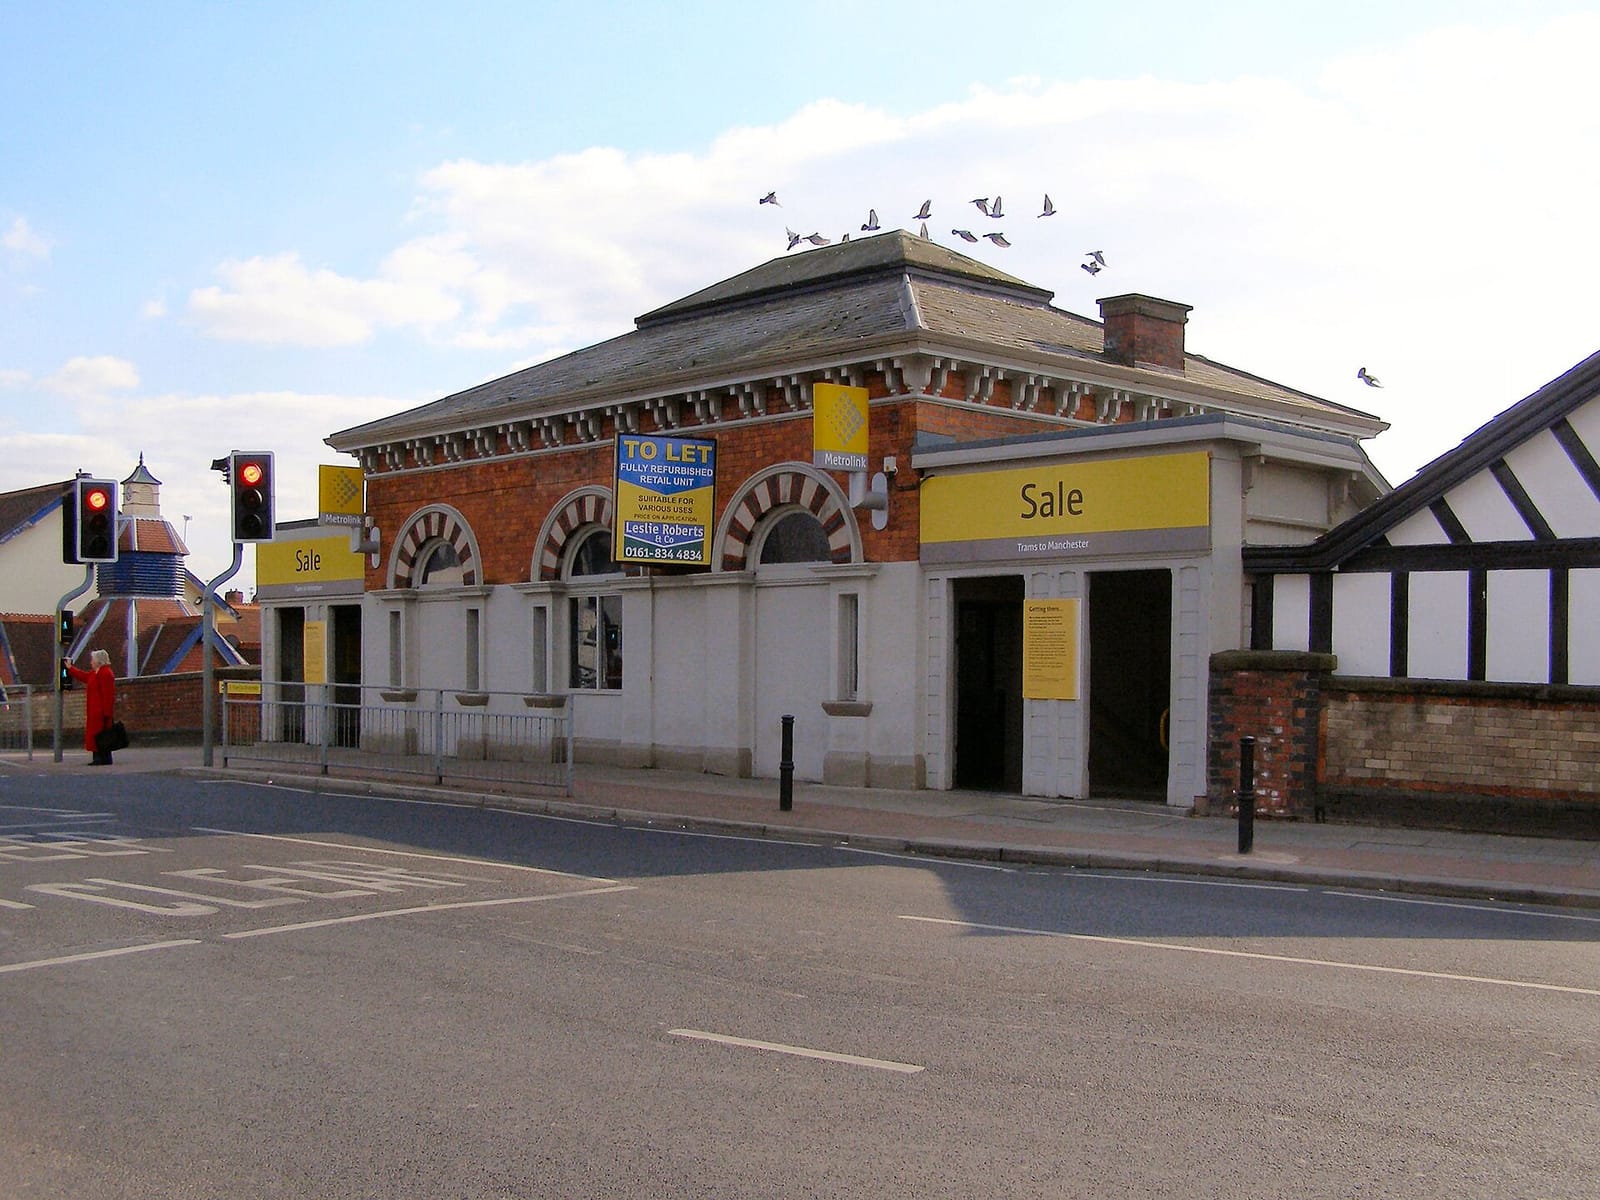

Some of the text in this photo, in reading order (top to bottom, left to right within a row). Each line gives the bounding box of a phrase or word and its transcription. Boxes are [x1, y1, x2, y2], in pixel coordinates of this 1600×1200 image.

[623, 440, 713, 463] TO LET
[824, 453, 866, 468] Metrolink
[620, 463, 713, 477] FULLY REFURBISHED
[640, 475, 694, 487] RETAIL UNIT
[678, 497, 694, 505] FOR
[1020, 481, 1083, 519] Sale
[638, 504, 693, 514] VARIOUS USES
[325, 514, 362, 525] Metrolink
[625, 521, 704, 537] Leslie Roberts
[663, 535, 674, 544] Co
[1017, 540, 1089, 553] Trams to Manchester
[295, 548, 321, 572] Sale
[676, 549, 703, 561] 4834
[24, 860, 502, 917] CLEAR
